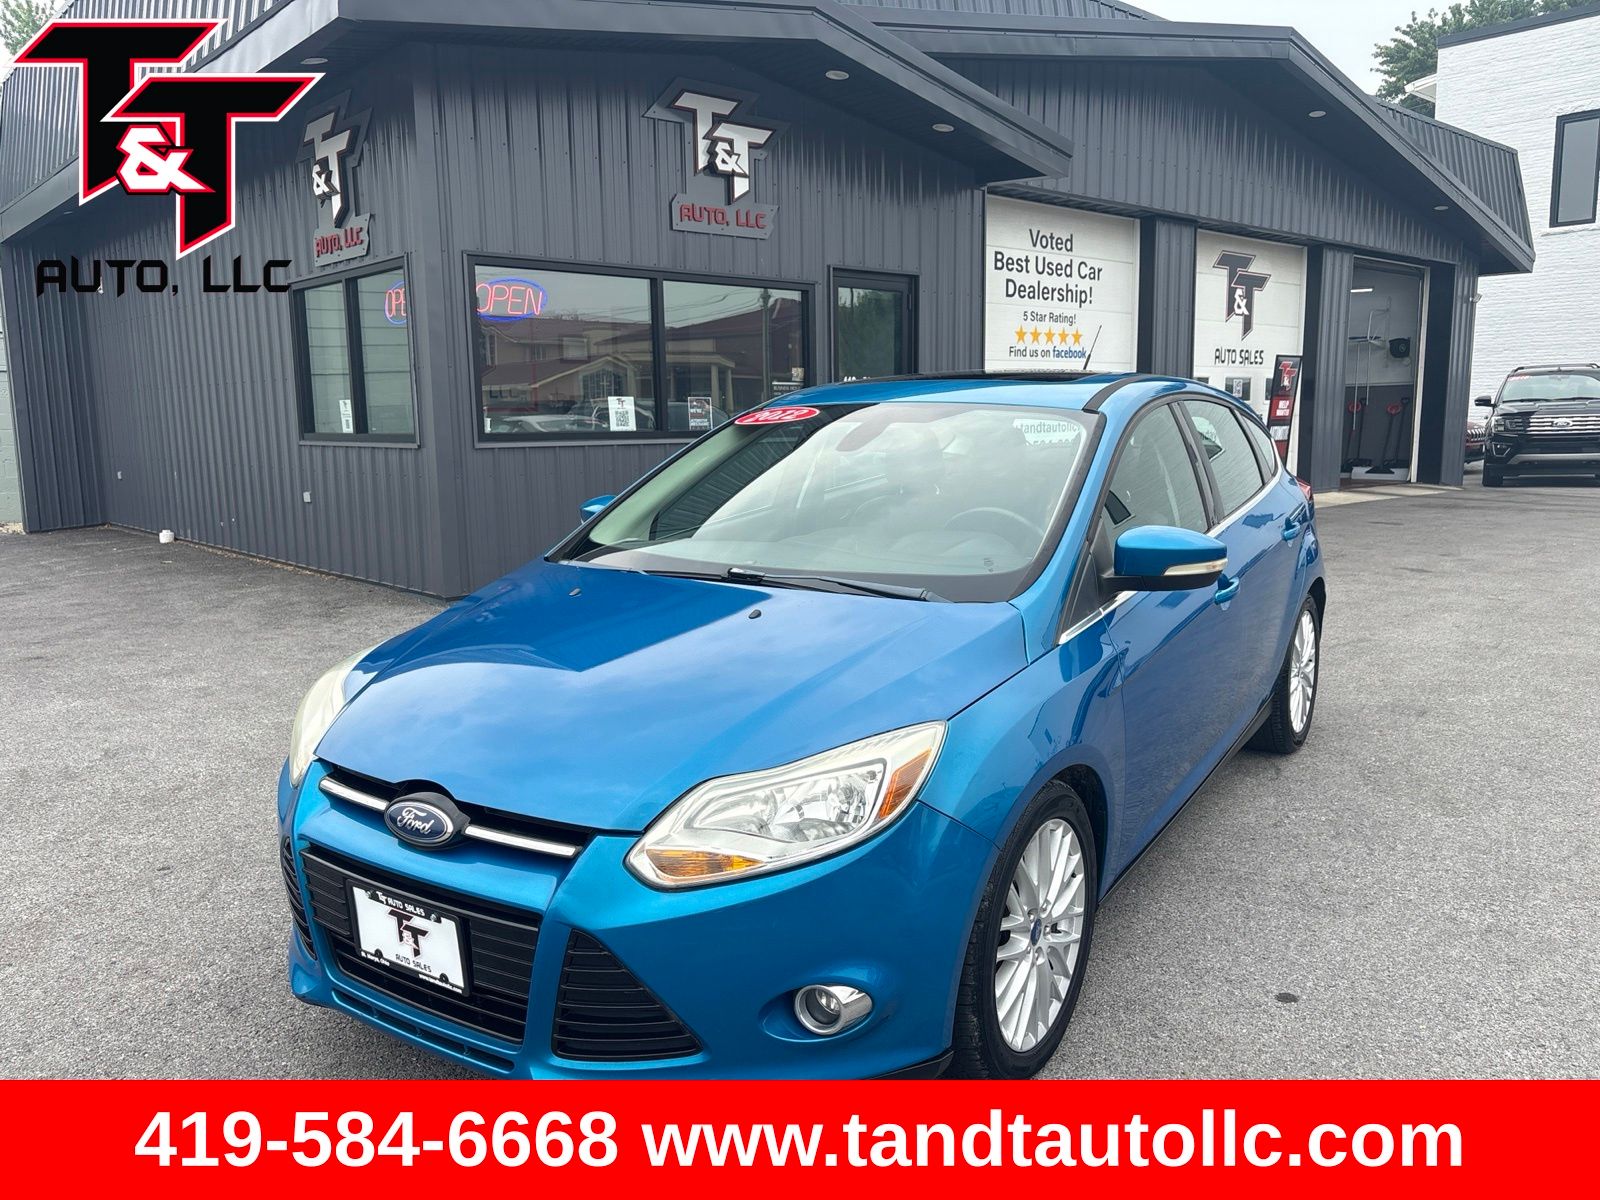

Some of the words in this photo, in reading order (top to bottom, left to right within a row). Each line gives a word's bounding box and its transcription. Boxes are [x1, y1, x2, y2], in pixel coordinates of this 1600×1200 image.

[672, 90, 775, 203] T&T
[303, 111, 351, 227] T&T
[679, 203, 729, 227] AUTO,
[735, 209, 768, 229] LLC
[344, 227, 364, 248] LLC
[1028, 228, 1074, 252] Voted
[994, 250, 1031, 274] Best
[1035, 256, 1073, 278] Used
[1077, 261, 1103, 281] Car
[385, 288, 407, 318] OPE
[476, 283, 543, 316] OPEN
[1005, 278, 1093, 308] Dealership!
[1212, 250, 1272, 341] T&T
[1023, 310, 1028, 321] 5
[1030, 310, 1046, 322] Star
[1048, 312, 1077, 326] Rating!
[1008, 346, 1027, 358] Find
[1029, 349, 1038, 358] us
[1041, 350, 1051, 358] on
[1052, 346, 1087, 359] facebook
[1214, 348, 1236, 366] AUTO
[1239, 348, 1264, 366] SALES
[397, 806, 435, 835] Ford
[387, 898, 403, 909] AUTO
[404, 903, 425, 917] SALES
[387, 908, 430, 958] T&T
[395, 954, 411, 965] AUTO
[412, 960, 432, 973] SALES
